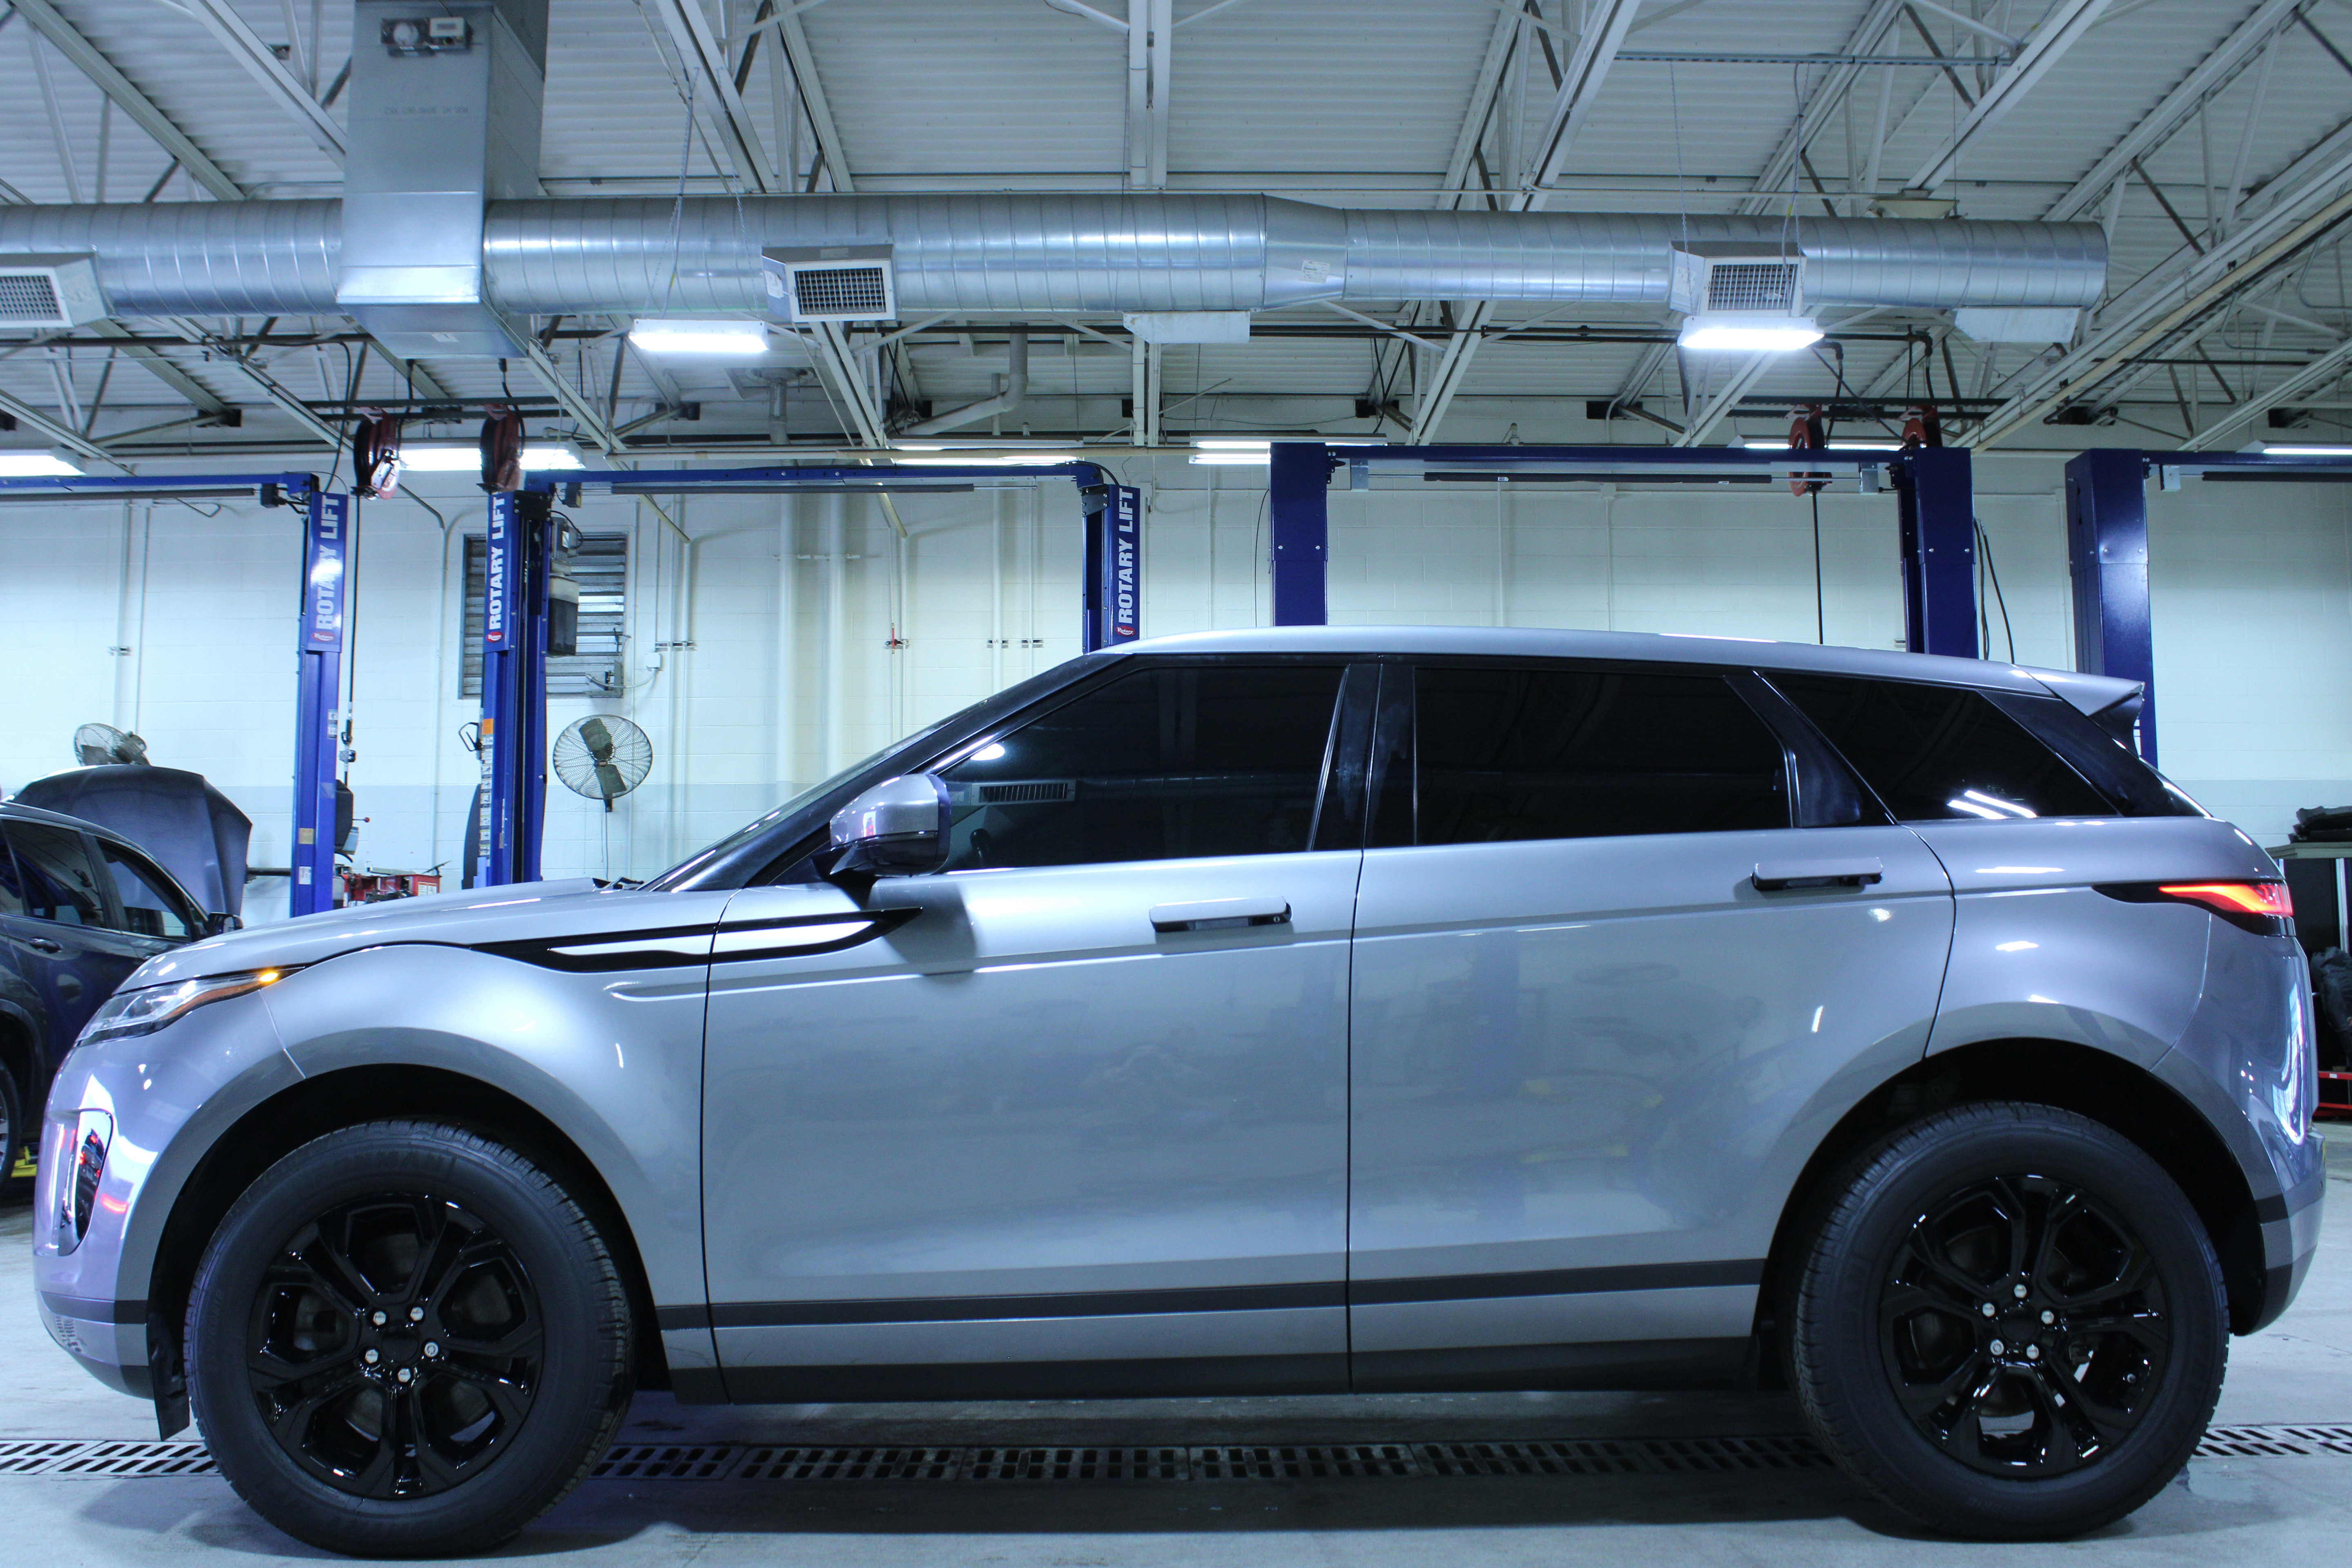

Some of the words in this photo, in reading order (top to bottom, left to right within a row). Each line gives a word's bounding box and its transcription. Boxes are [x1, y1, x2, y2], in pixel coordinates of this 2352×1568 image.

[321, 495, 339, 539] LIFT
[492, 497, 506, 540] LIFT
[1119, 488, 1133, 532] LIFT
[316, 544, 336, 630] ROTAY
[489, 546, 504, 630] ROTARY
[1118, 538, 1133, 624] ROTARY
